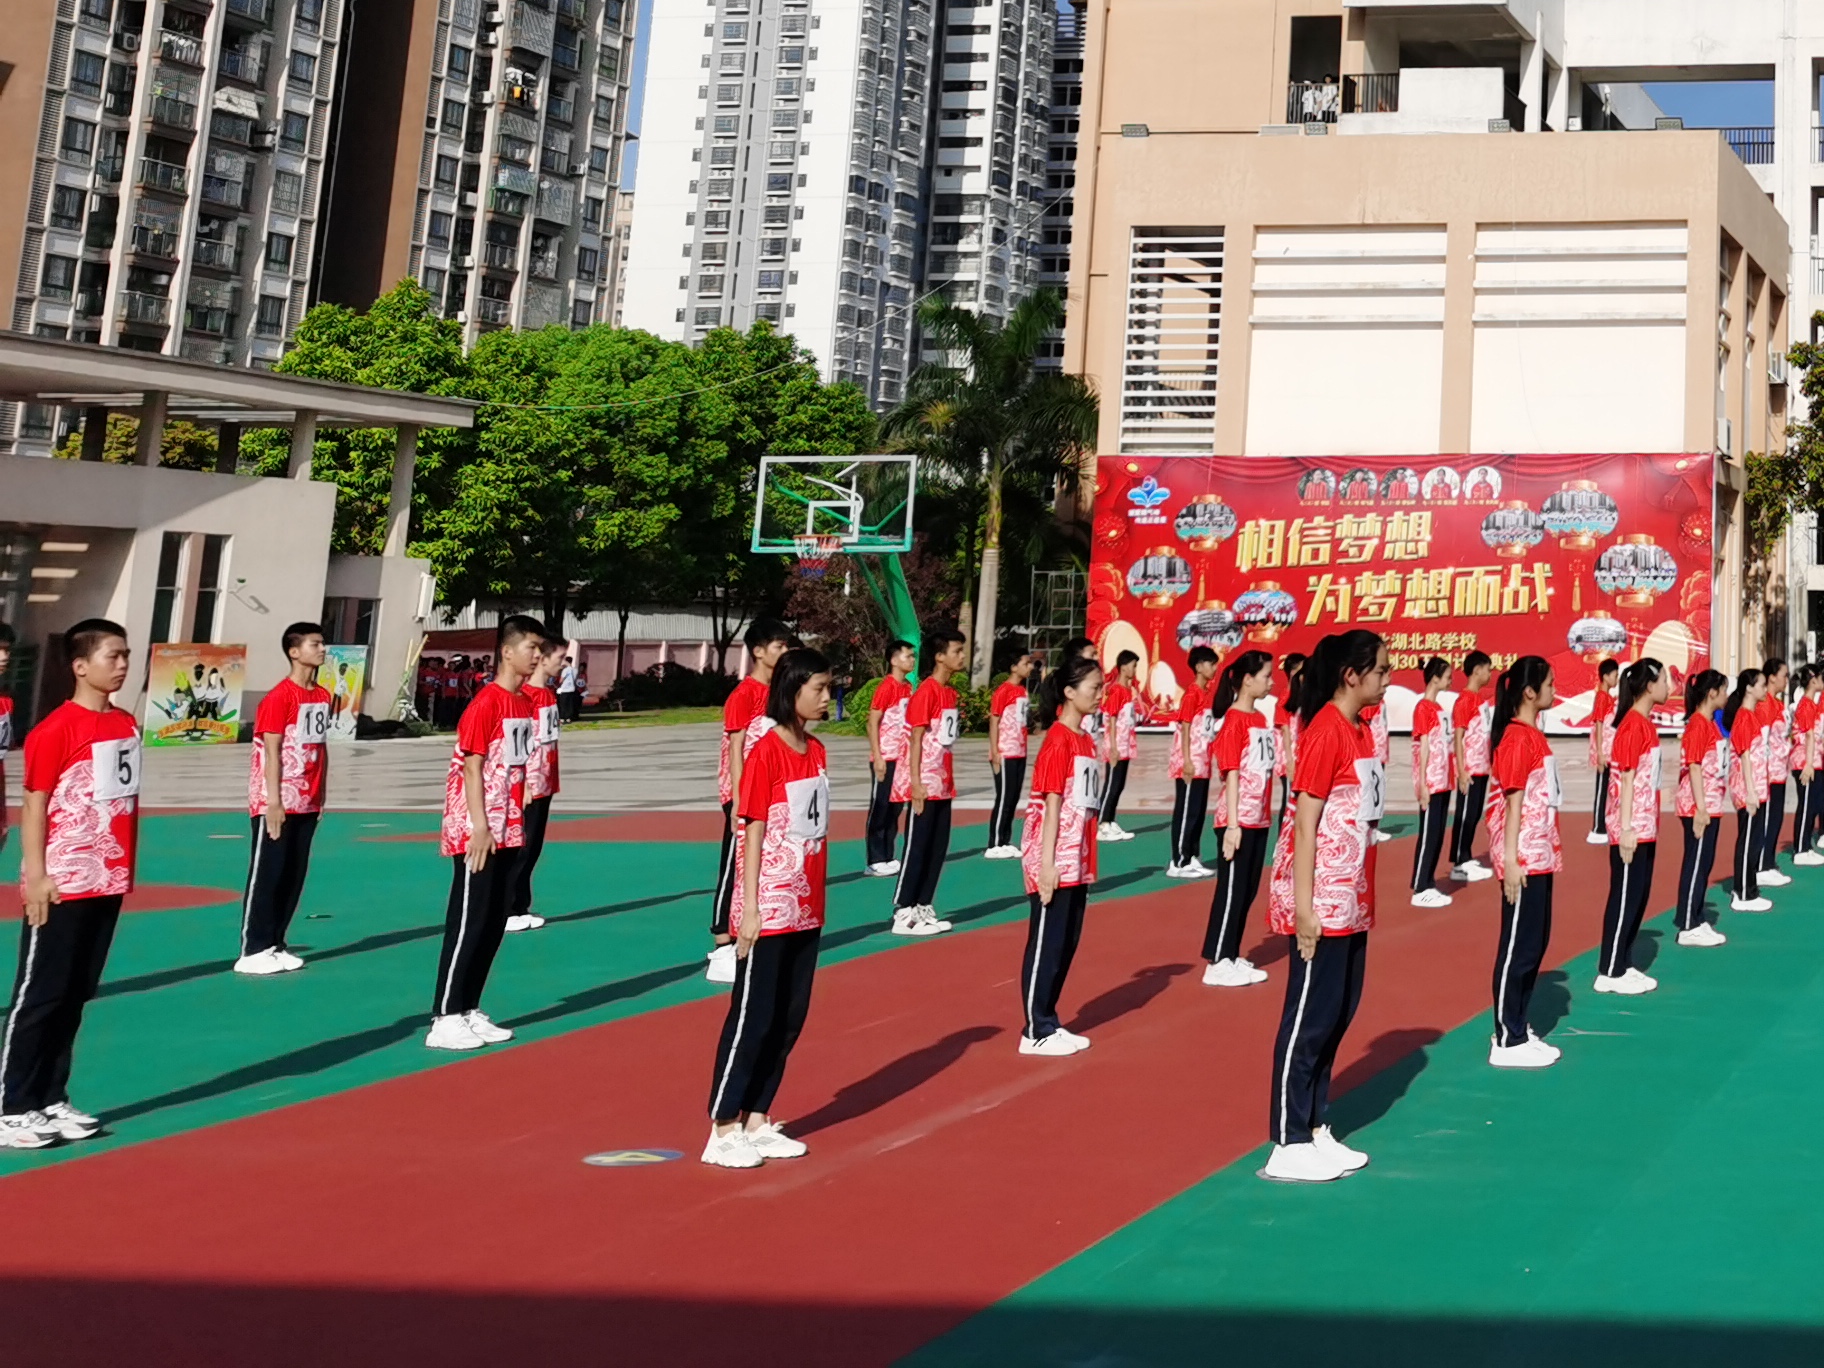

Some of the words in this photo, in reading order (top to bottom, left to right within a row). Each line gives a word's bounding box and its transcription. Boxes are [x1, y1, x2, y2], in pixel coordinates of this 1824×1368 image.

[1235, 510, 1433, 573] 相信梦想
[1304, 562, 1553, 626] 为梦想而战
[304, 711, 325, 735] 18
[1258, 736, 1275, 761] 16
[118, 749, 133, 785] 5
[1083, 767, 1099, 798] 10
[808, 789, 819, 827] 4
